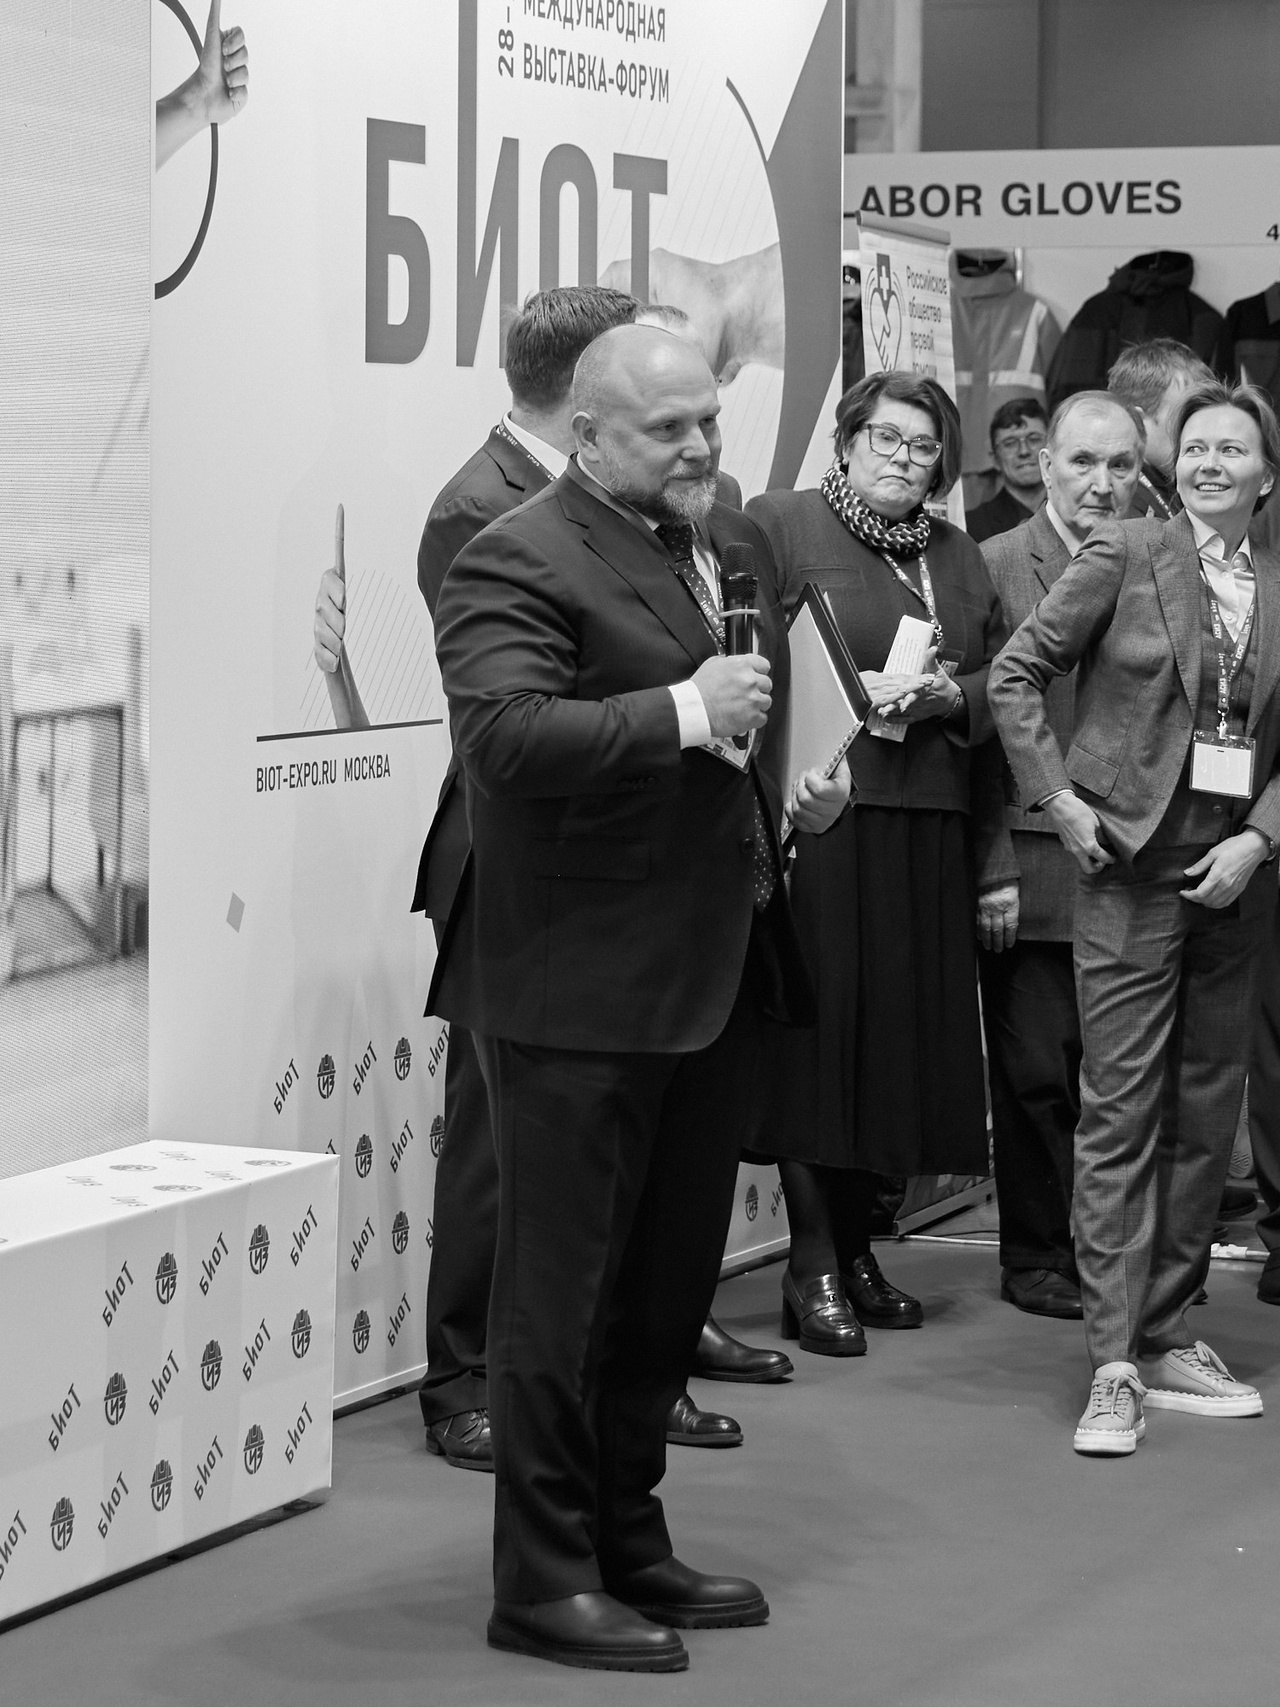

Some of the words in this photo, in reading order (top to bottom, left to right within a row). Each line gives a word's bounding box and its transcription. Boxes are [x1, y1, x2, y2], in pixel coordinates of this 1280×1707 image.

[523, 42, 669, 103] ВЫСТАВКА-ФОРУМ
[844, 183, 982, 218] ABOR
[1001, 180, 1182, 217] GLOVES
[364, 112, 668, 368] БИОТ
[256, 759, 337, 792] BIOT-EXPO.RU
[344, 753, 391, 782] МОСКВА
